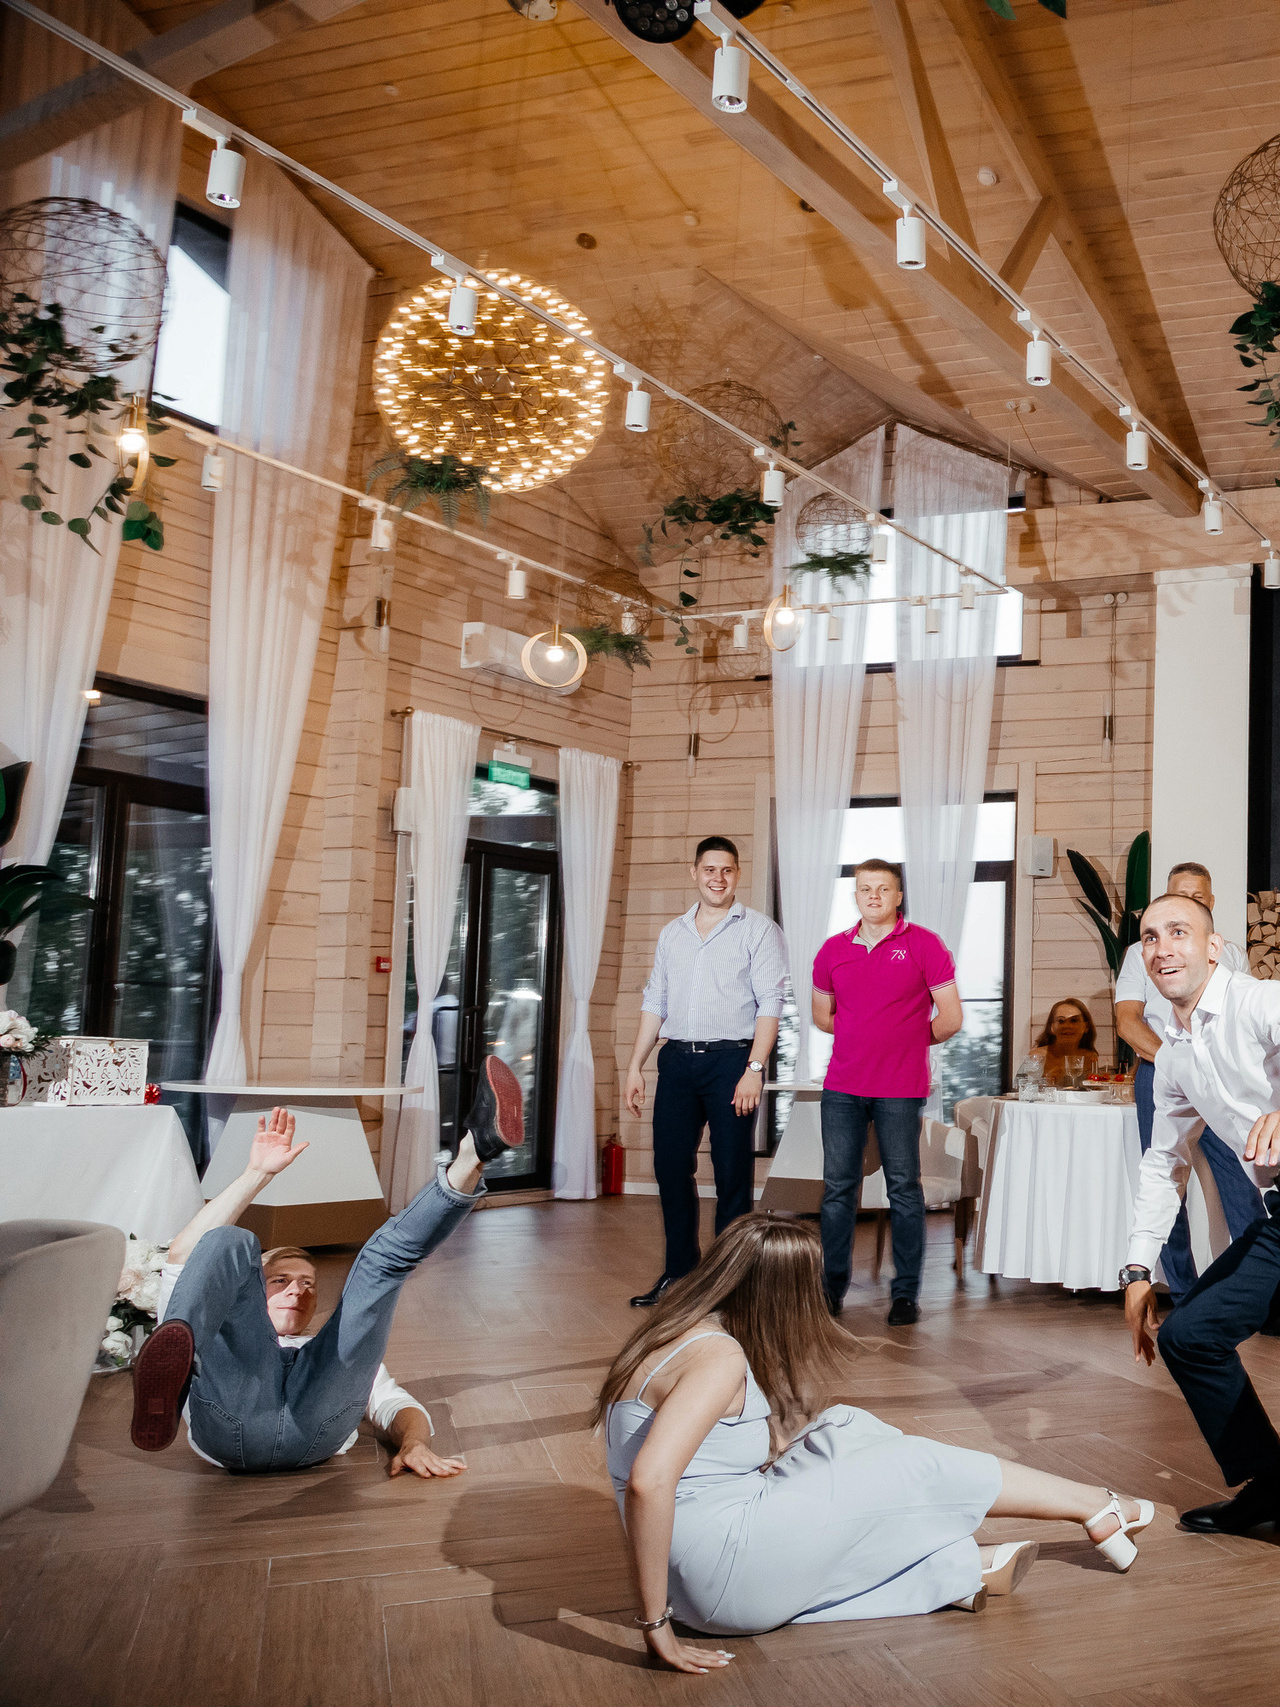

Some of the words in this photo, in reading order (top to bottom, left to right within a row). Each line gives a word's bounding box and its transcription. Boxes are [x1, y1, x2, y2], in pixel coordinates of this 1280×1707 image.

[891, 949, 906, 960] 78
[76, 1067, 96, 1080] Mr
[101, 1068, 111, 1080] &
[116, 1068, 140, 1080] Mrs
